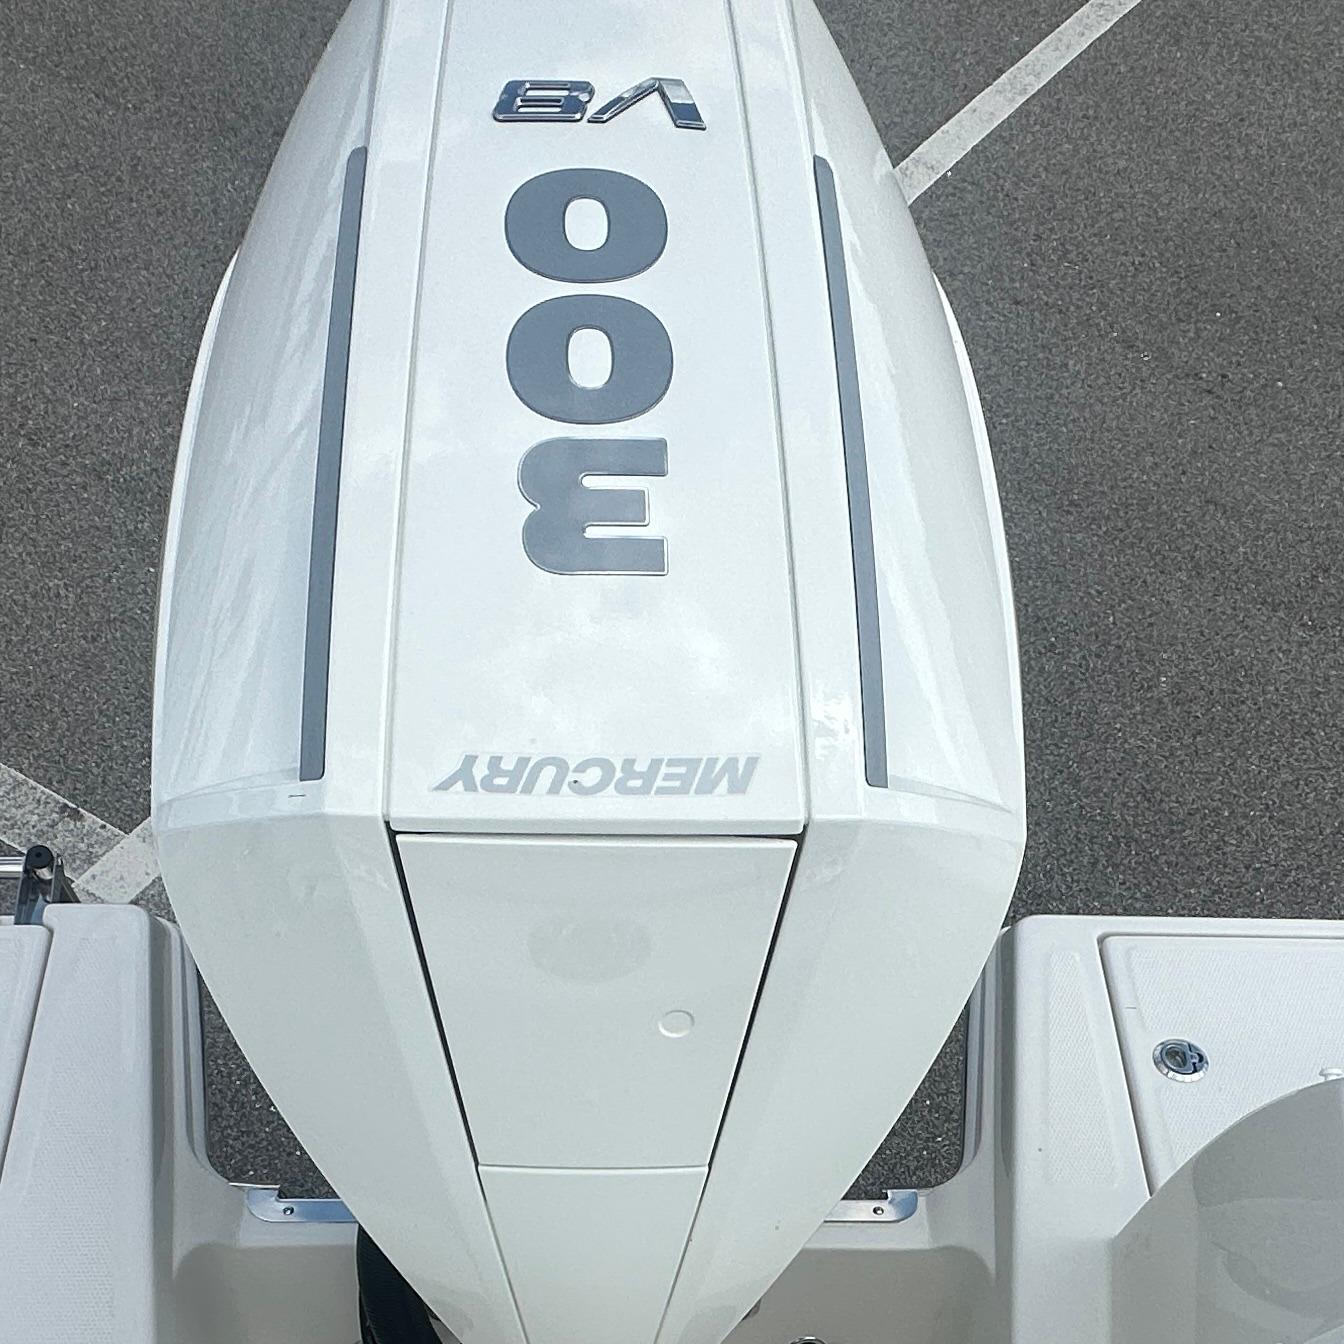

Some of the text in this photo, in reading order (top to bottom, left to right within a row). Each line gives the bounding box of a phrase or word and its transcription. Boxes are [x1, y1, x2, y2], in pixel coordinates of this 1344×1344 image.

[492, 76, 707, 131] V8
[504, 167, 674, 577] 300
[430, 753, 760, 796] MERCURY
